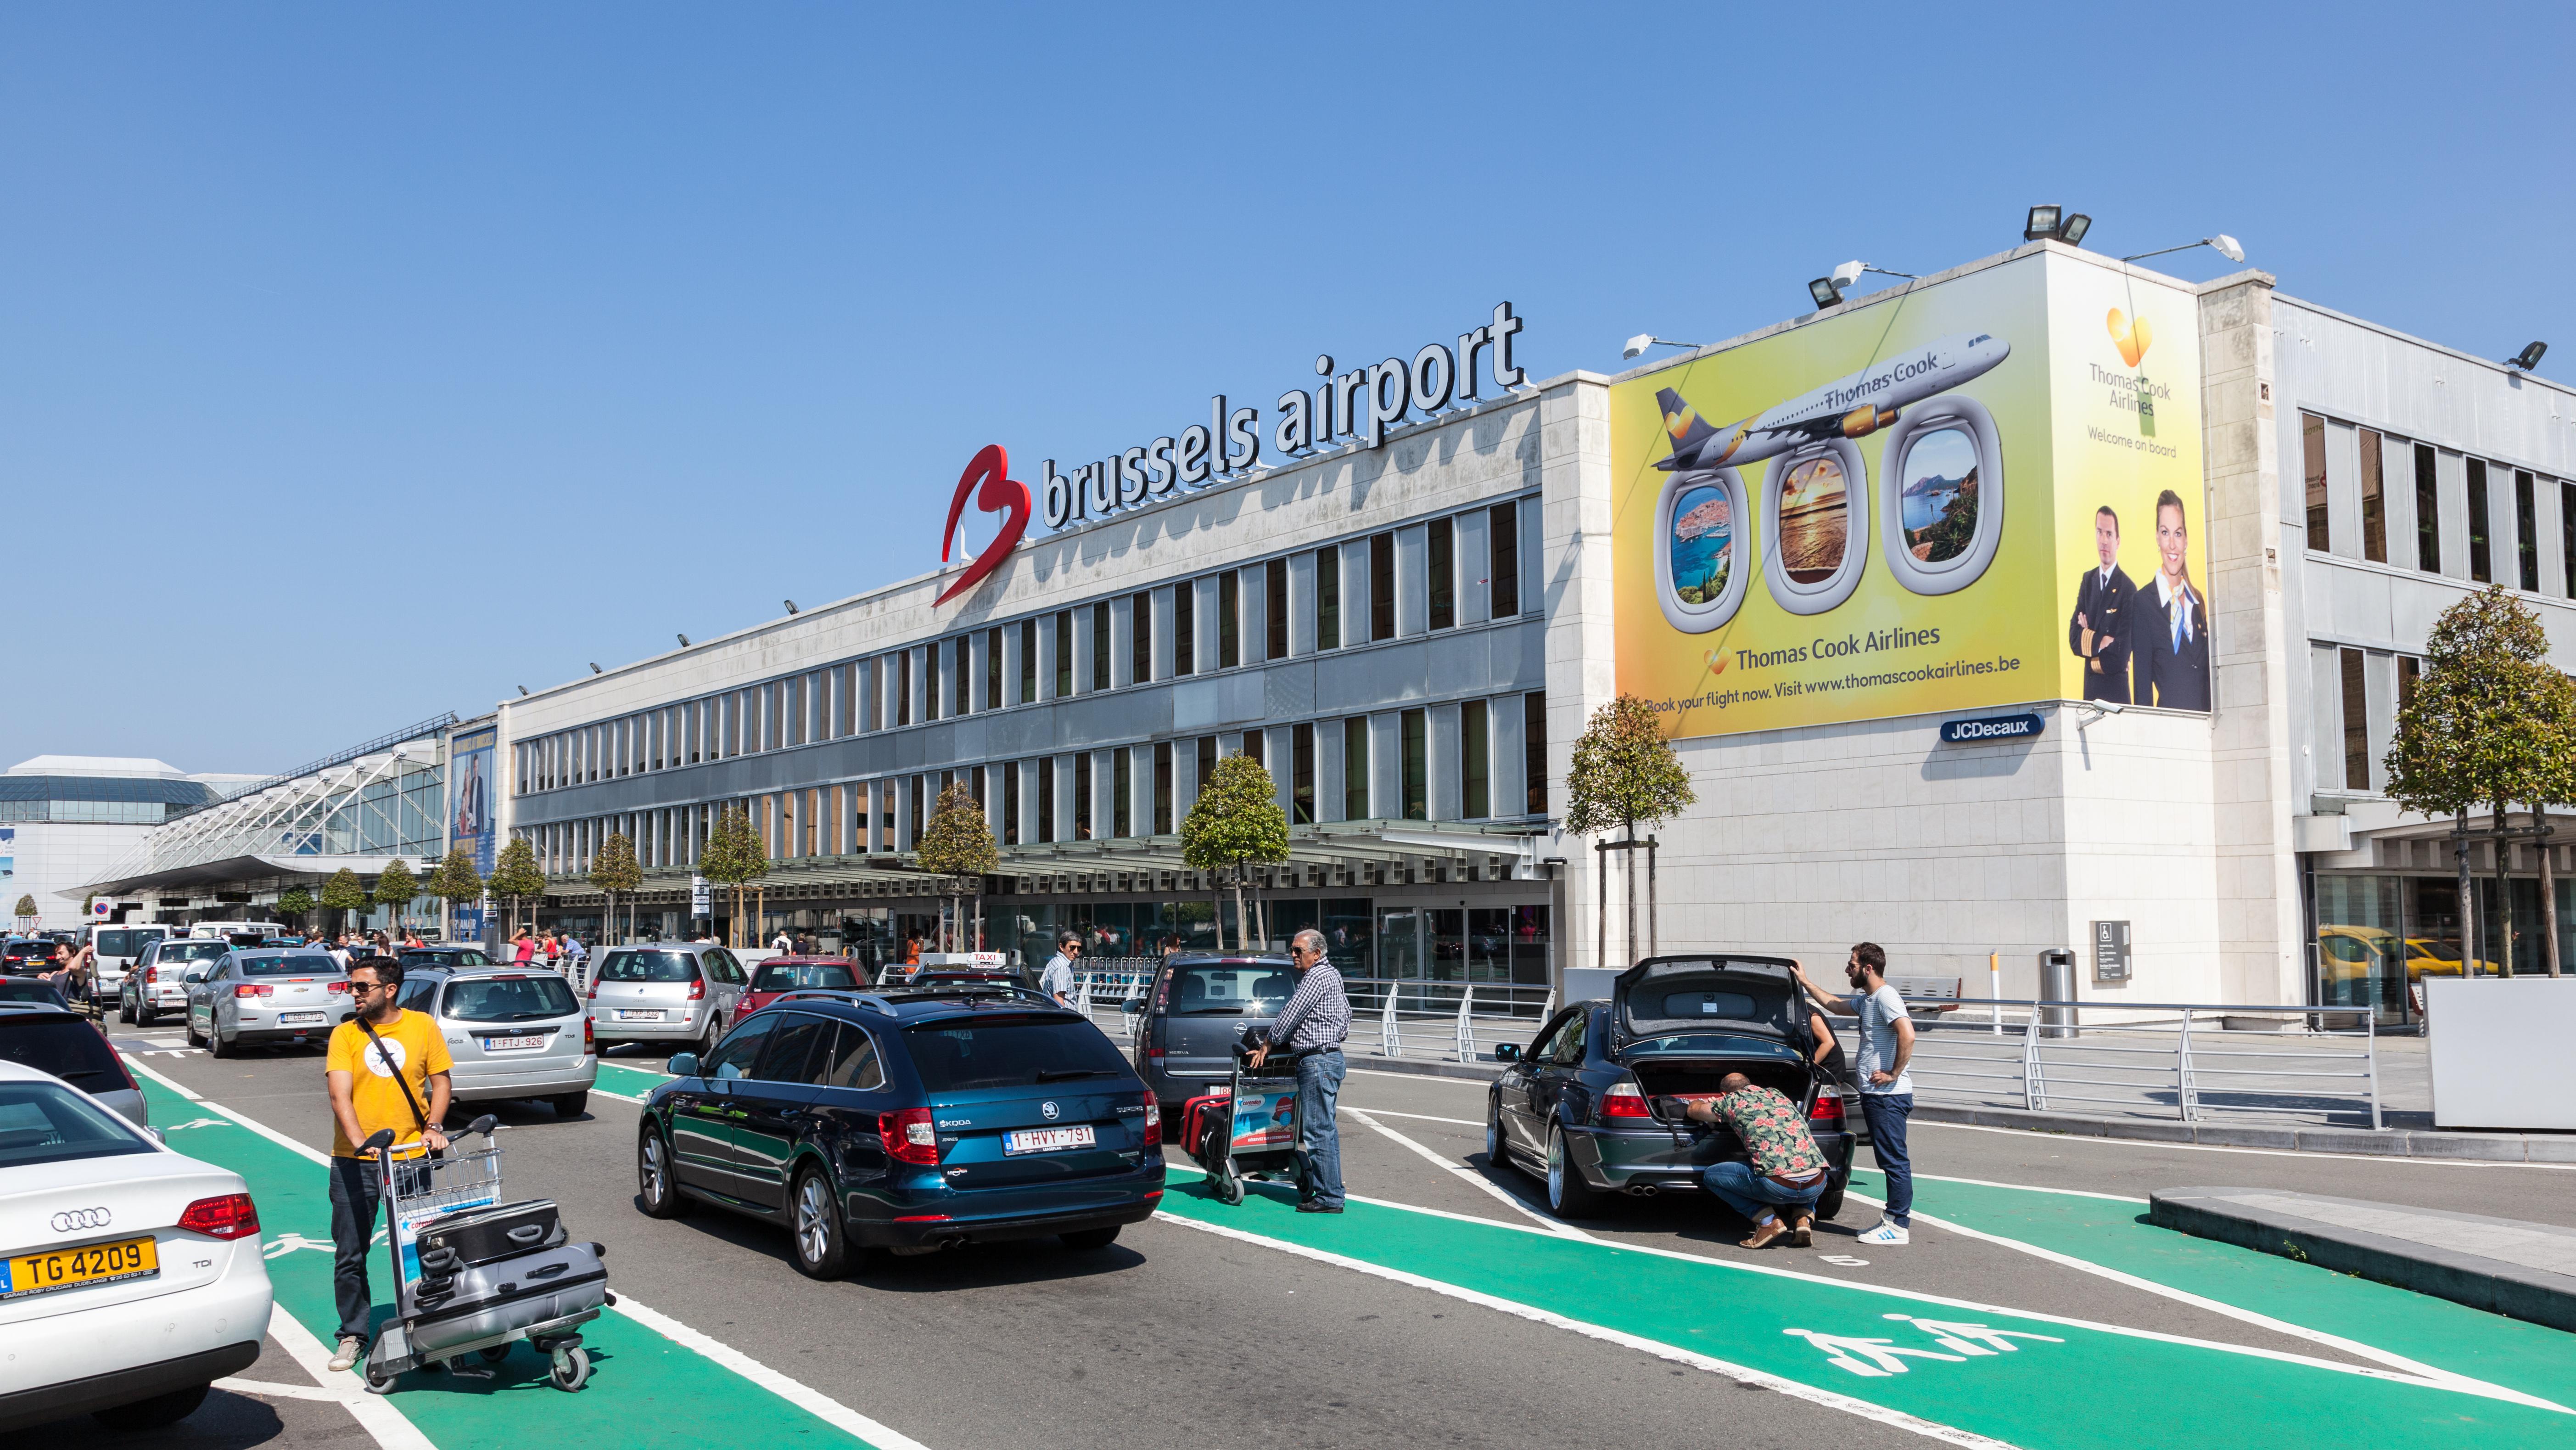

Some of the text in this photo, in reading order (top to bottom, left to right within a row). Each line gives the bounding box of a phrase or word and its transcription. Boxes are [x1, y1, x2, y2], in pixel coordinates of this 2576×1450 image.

[1824, 351, 1940, 410] Thomas Cook
[2089, 362, 2171, 401] Thomas Cook
[1042, 300, 1525, 528] brussels airport
[2109, 390, 2154, 417] Airlines
[2087, 424, 2177, 459] Welcome on board
[1736, 625, 1941, 670] Thomas Cook Airlines
[1646, 655, 2021, 714] Book your flight now. Visit www.thomascookairlines.be
[1951, 718, 2029, 740] JCDecaux
[492, 1037, 543, 1047] 1-FTJ-926
[939, 1119, 971, 1128] ŠKODA
[1014, 1127, 1091, 1147] 1-HVY-791
[192, 1259, 212, 1269] TDI
[1818, 1255, 1870, 1266] 5
[3, 1291, 28, 1299] GARAGE
[45, 1283, 73, 1293] CRUCIANI
[74, 1277, 108, 1288] DUDELANGE
